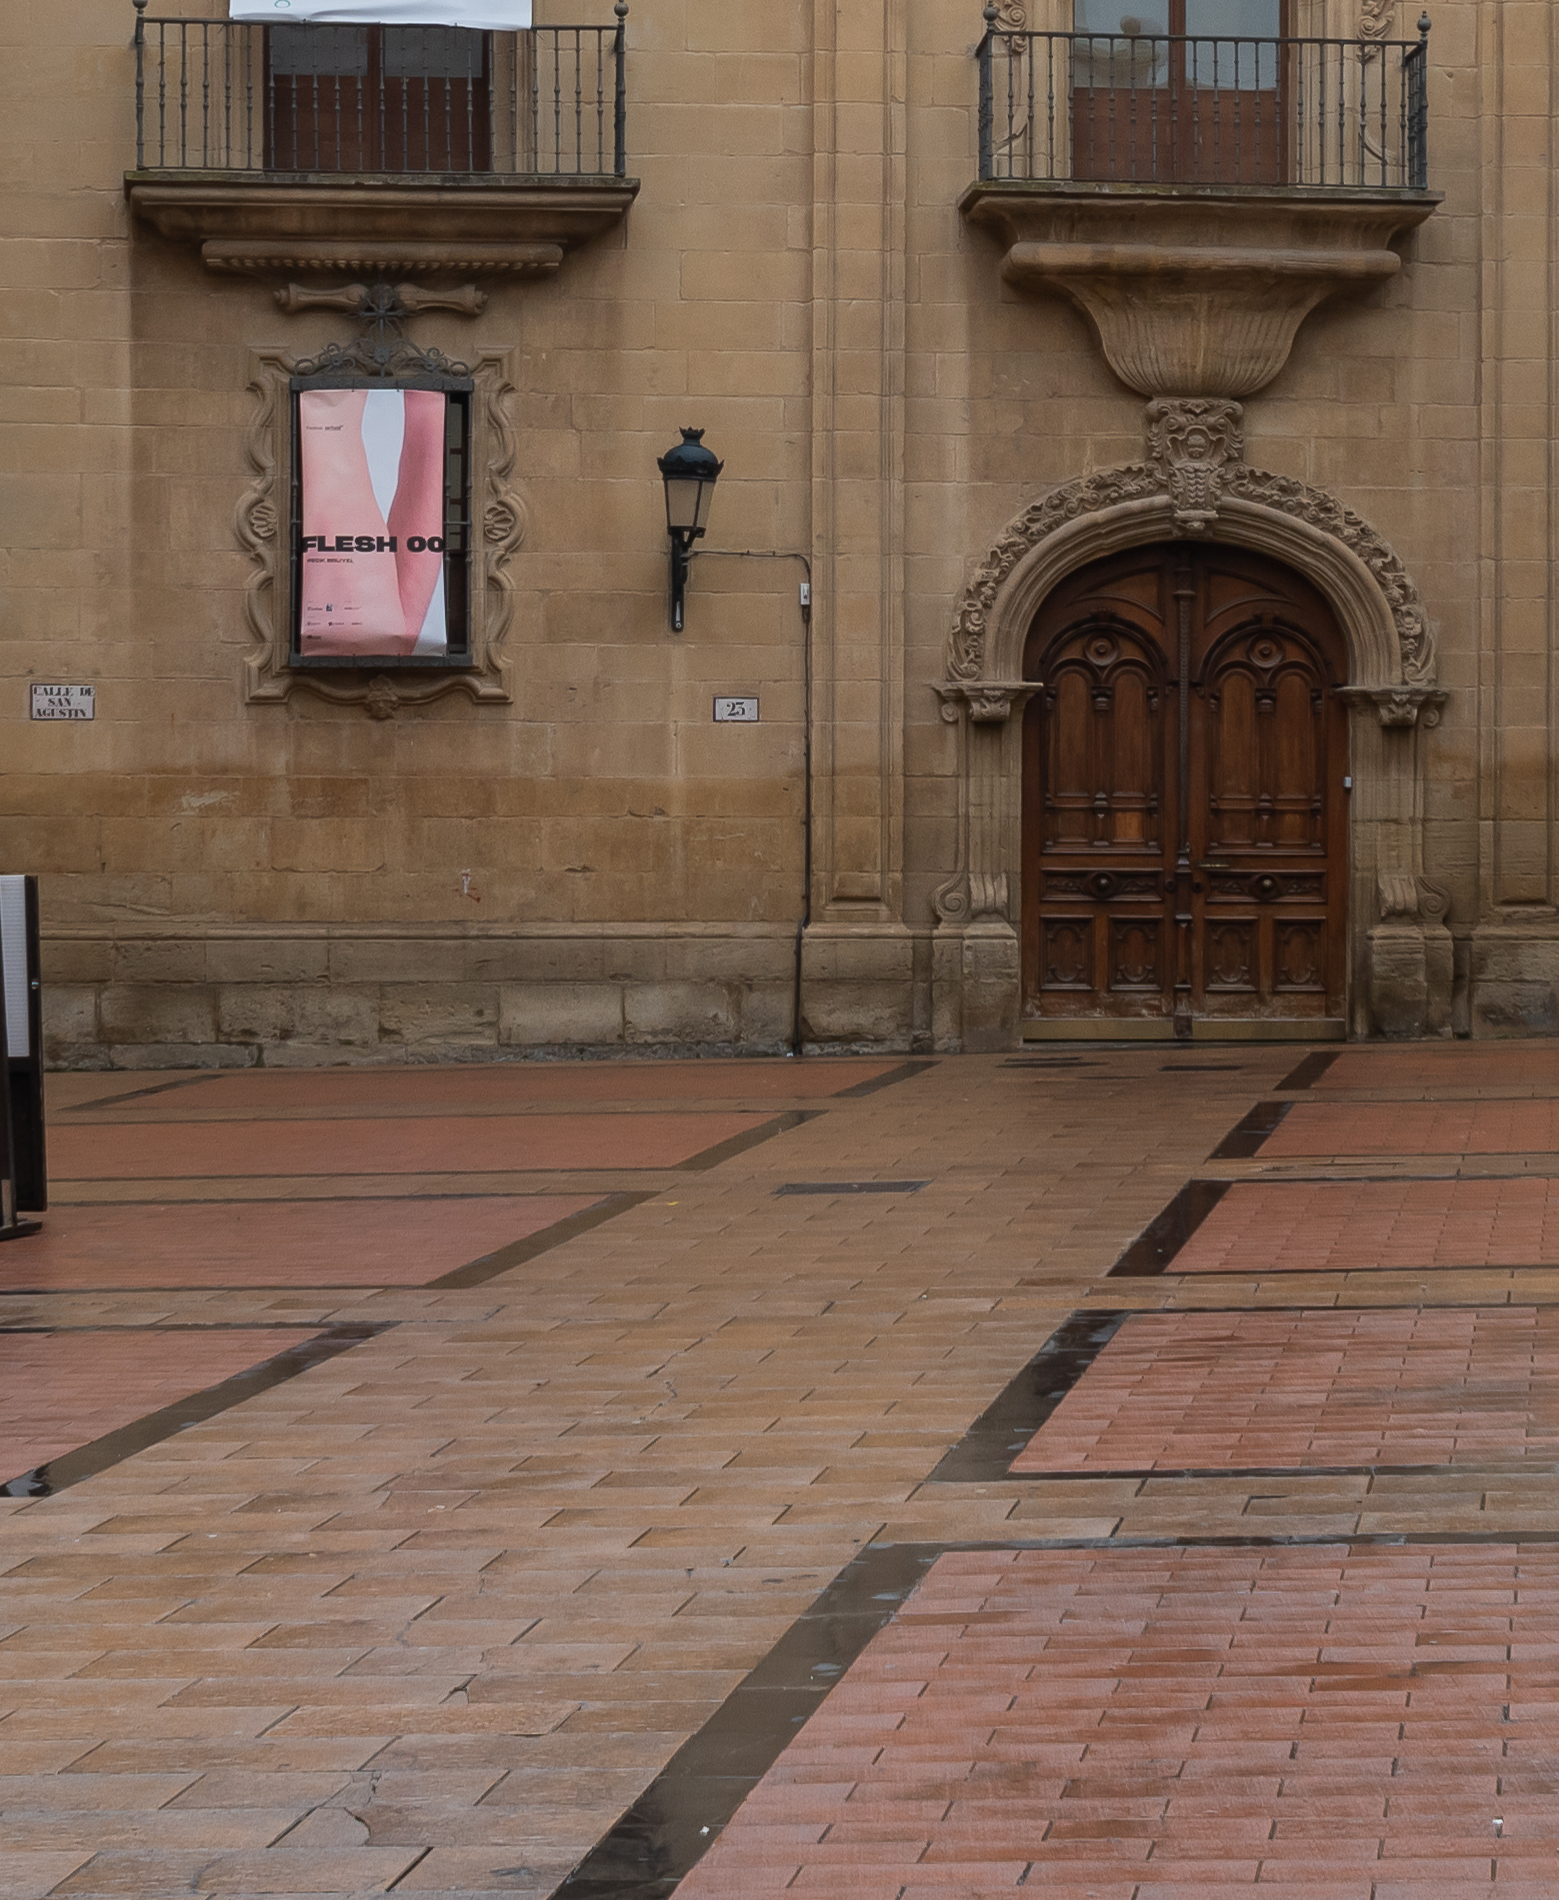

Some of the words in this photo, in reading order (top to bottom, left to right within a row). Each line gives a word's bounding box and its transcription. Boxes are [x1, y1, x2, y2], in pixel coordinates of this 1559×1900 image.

[302, 535, 398, 553] FLESH
[33, 686, 74, 697] CALLE
[79, 687, 95, 697] DE
[47, 697, 72, 707] SAN
[35, 708, 86, 718] AGUSTIN
[726, 701, 746, 717] 25
